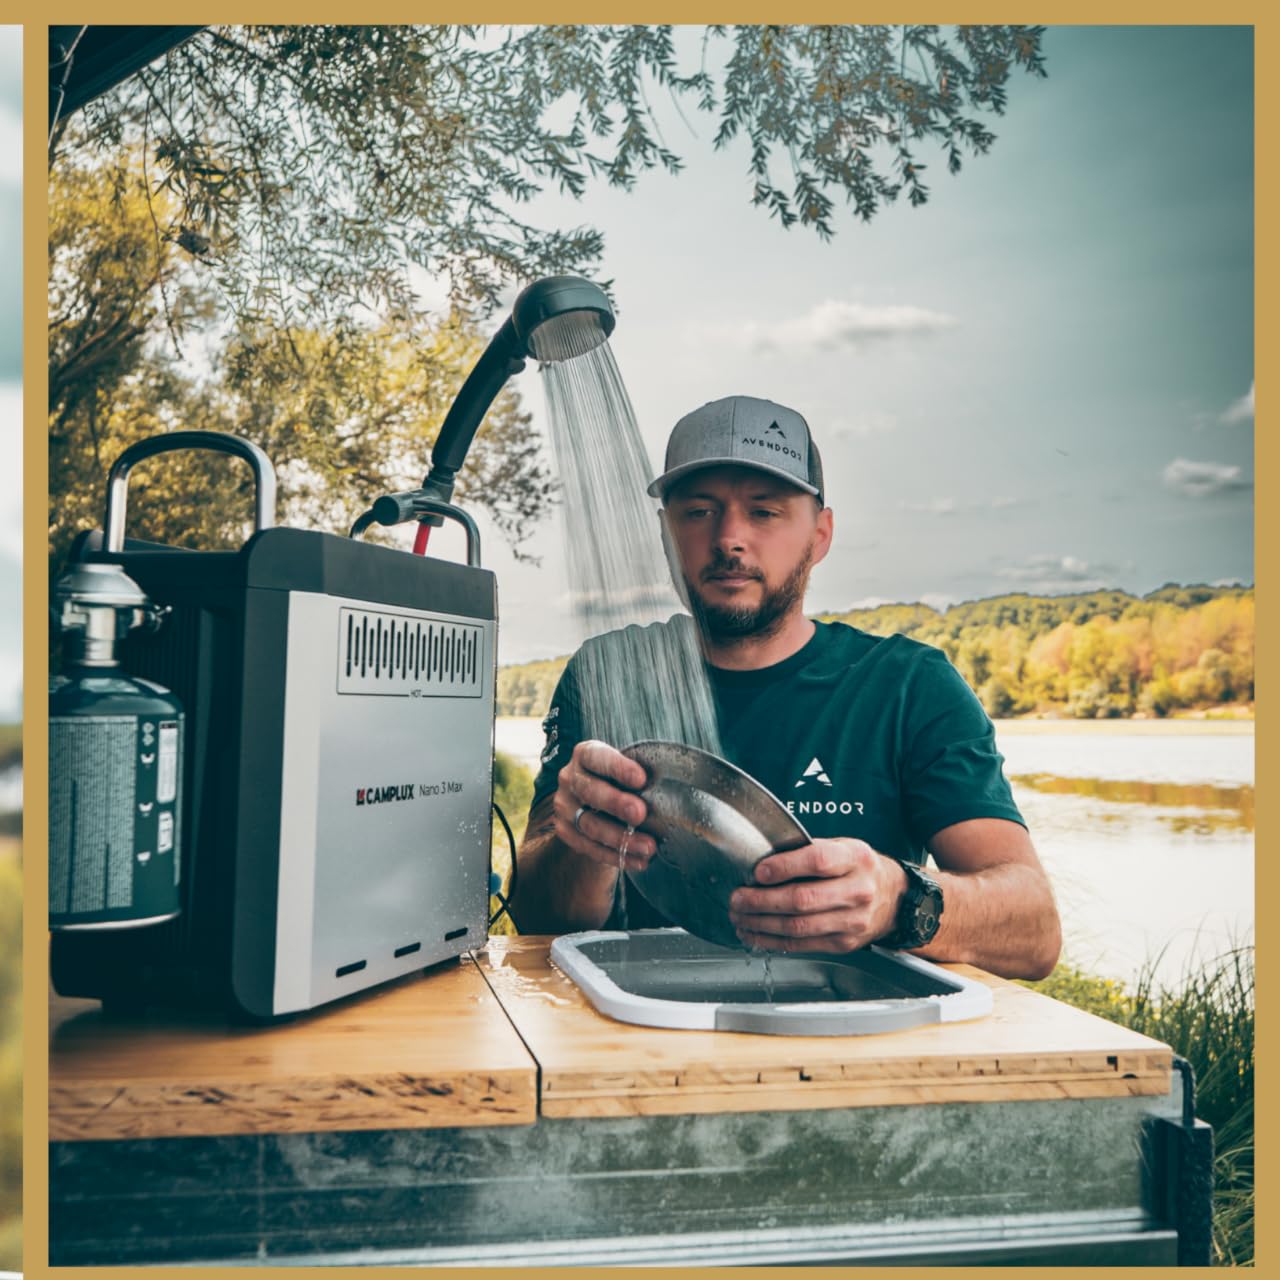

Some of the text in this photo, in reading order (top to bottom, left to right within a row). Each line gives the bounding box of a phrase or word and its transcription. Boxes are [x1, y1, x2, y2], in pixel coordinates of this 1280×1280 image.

[742, 438, 802, 461] AVENDOOR
[366, 780, 463, 805] CAMPLUX Nano 3 Max
[786, 800, 864, 815] ENDOOR
